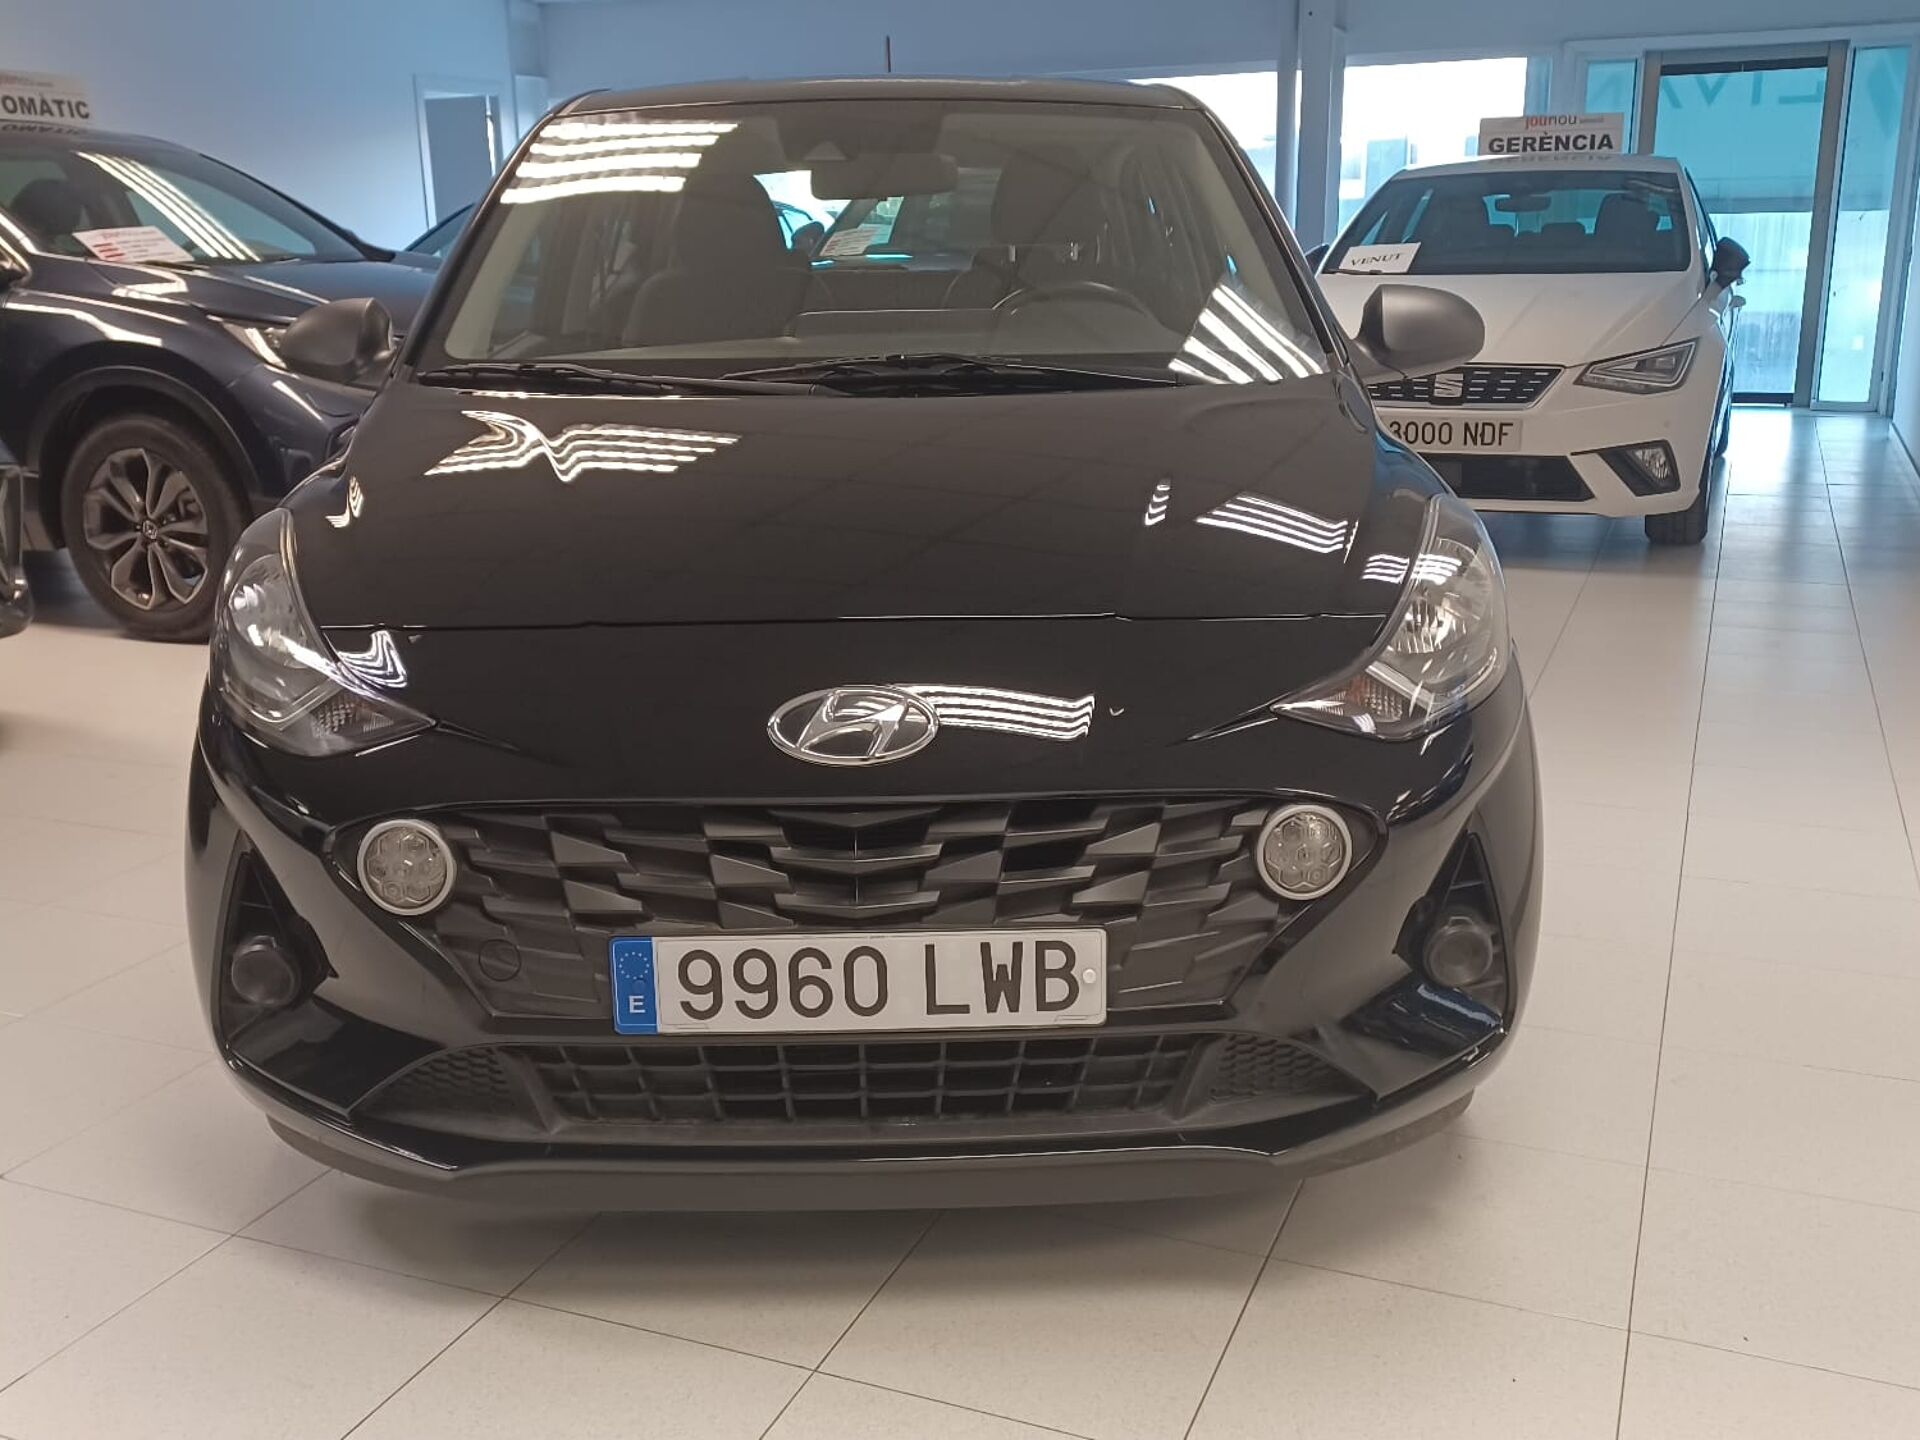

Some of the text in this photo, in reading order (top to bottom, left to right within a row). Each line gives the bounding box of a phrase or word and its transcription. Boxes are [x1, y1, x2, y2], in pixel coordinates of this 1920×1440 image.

[1488, 131, 1613, 153] GERÈNCIA
[1351, 252, 1402, 266] VENUT
[1389, 420, 1514, 446] 3000 NDF
[628, 940, 1080, 1021] E 9960 LWB
